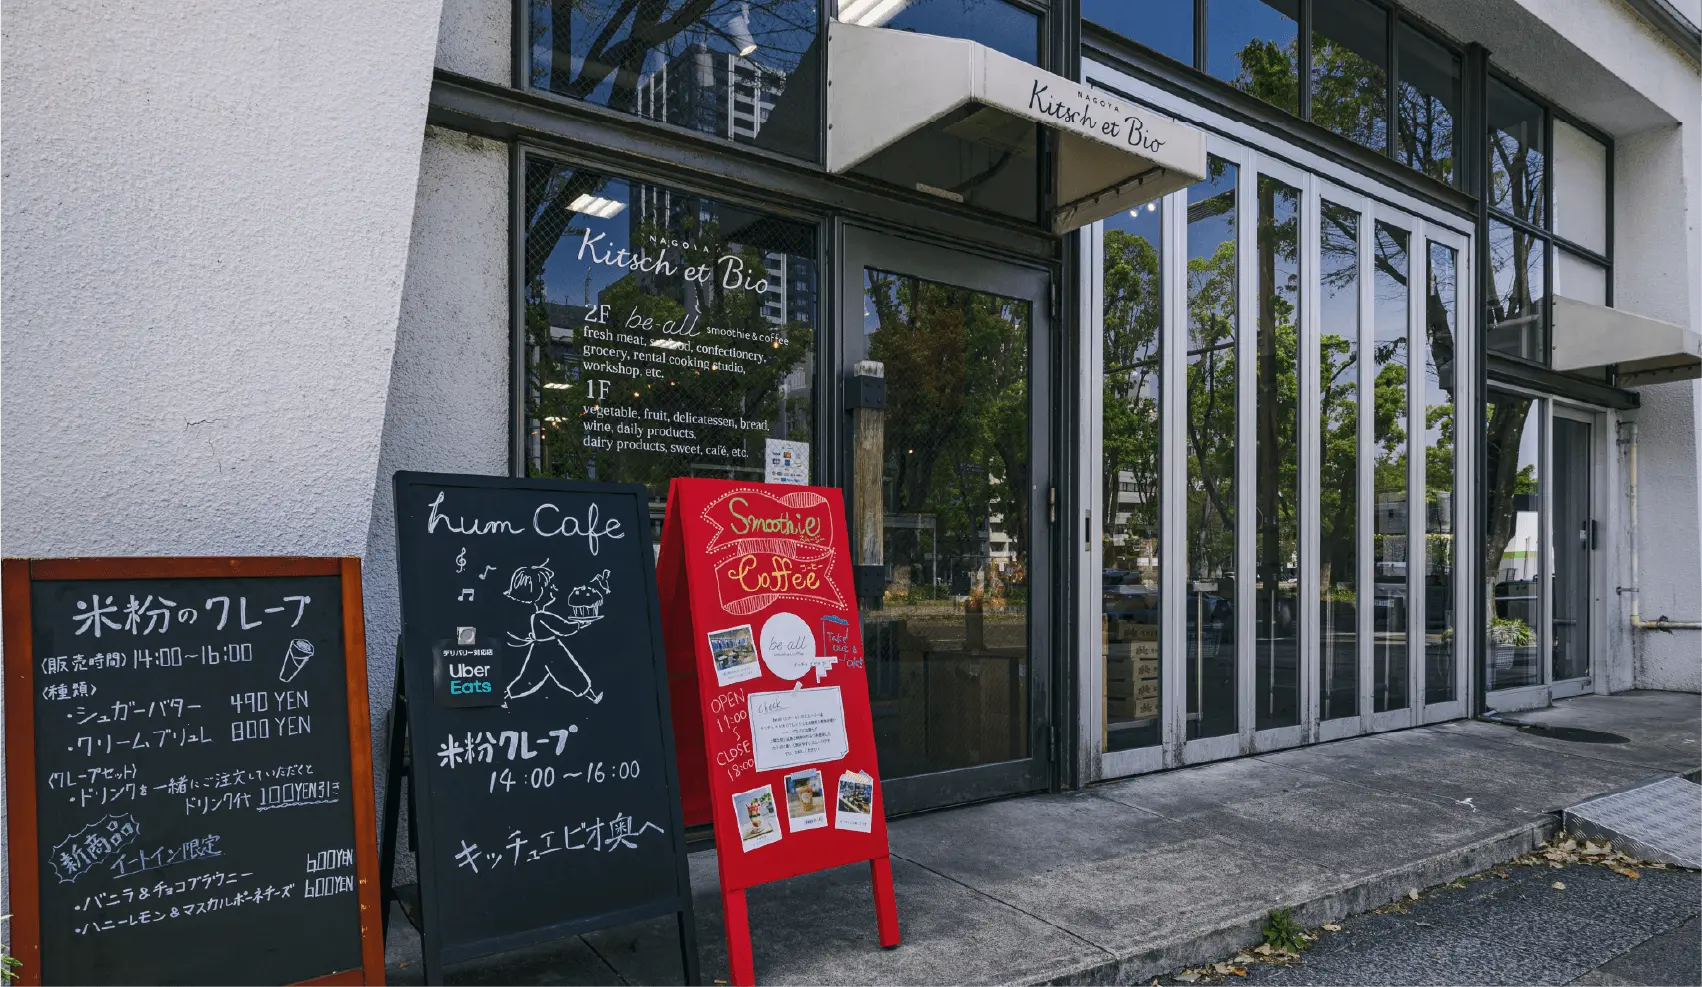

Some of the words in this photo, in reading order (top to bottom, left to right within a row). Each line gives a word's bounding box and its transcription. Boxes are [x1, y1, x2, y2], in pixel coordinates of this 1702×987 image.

[1078, 90, 1120, 112] NAGOYA
[1028, 80, 1097, 128] Kitsch
[1102, 121, 1120, 137] et
[1124, 116, 1166, 152] Bio
[578, 227, 678, 276] Kitsch
[684, 264, 712, 283] et
[718, 255, 768, 294] Bio
[584, 304, 611, 324] 2F
[583, 326, 613, 341] fresh
[616, 333, 647, 346] meat,
[582, 344, 630, 362] grocery,
[634, 352, 666, 364] rental
[668, 356, 710, 371] cooking
[646, 368, 664, 378] etc.
[587, 379, 612, 400] 1F
[583, 420, 614, 434] wine,
[616, 422, 644, 438] daily
[644, 408, 670, 422] fruit,
[673, 412, 738, 429] delicatessen,
[583, 435, 614, 451] dairy
[616, 439, 668, 453] products,
[732, 448, 749, 458] etc.
[428, 491, 526, 535] hum
[533, 502, 625, 556] Cafe
[728, 497, 821, 536] Smoothie
[728, 554, 820, 592] Coffee
[72, 594, 312, 638] 米粉のクレープ
[443, 648, 494, 657] デリバリー対応店
[449, 663, 490, 678] Uber
[450, 680, 492, 694] Eats
[230, 691, 268, 714] 490
[274, 690, 308, 712] YEN
[710, 688, 745, 714] OPEN
[758, 698, 781, 714] Check
[232, 718, 269, 742] 800
[274, 715, 310, 736] YEN
[717, 710, 747, 732] 11:00
[436, 724, 578, 769] 米粉クレープ
[716, 740, 750, 766] CLOSE
[728, 758, 754, 782] 18:00
[60, 820, 134, 874] 新商品
[110, 834, 222, 874] イートイン限定
